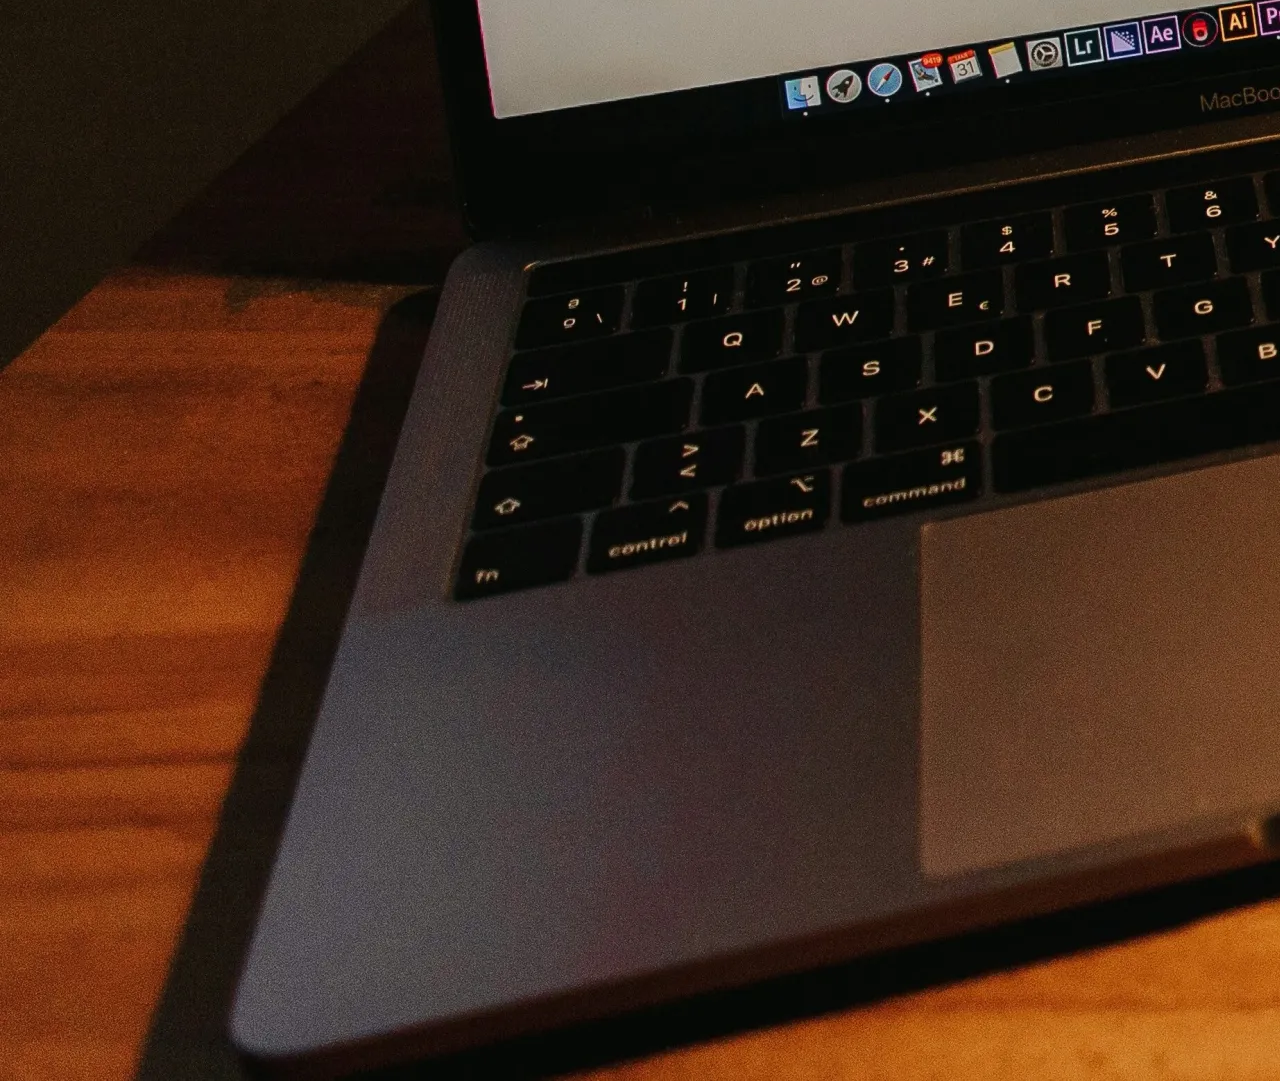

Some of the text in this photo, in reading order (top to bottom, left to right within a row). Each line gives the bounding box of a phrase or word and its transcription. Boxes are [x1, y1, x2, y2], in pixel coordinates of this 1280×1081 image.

[1228, 11, 1248, 30] Ai
[1150, 24, 1174, 44] Ae
[1074, 35, 1094, 56] Lr
[956, 61, 975, 77] 31
[1160, 253, 1177, 268] T
[948, 291, 963, 307] E
[832, 310, 859, 327] W
[723, 332, 743, 347] Q
[862, 360, 881, 376] S
[863, 477, 966, 507] command
[744, 509, 813, 531] option
[608, 531, 687, 557] control
